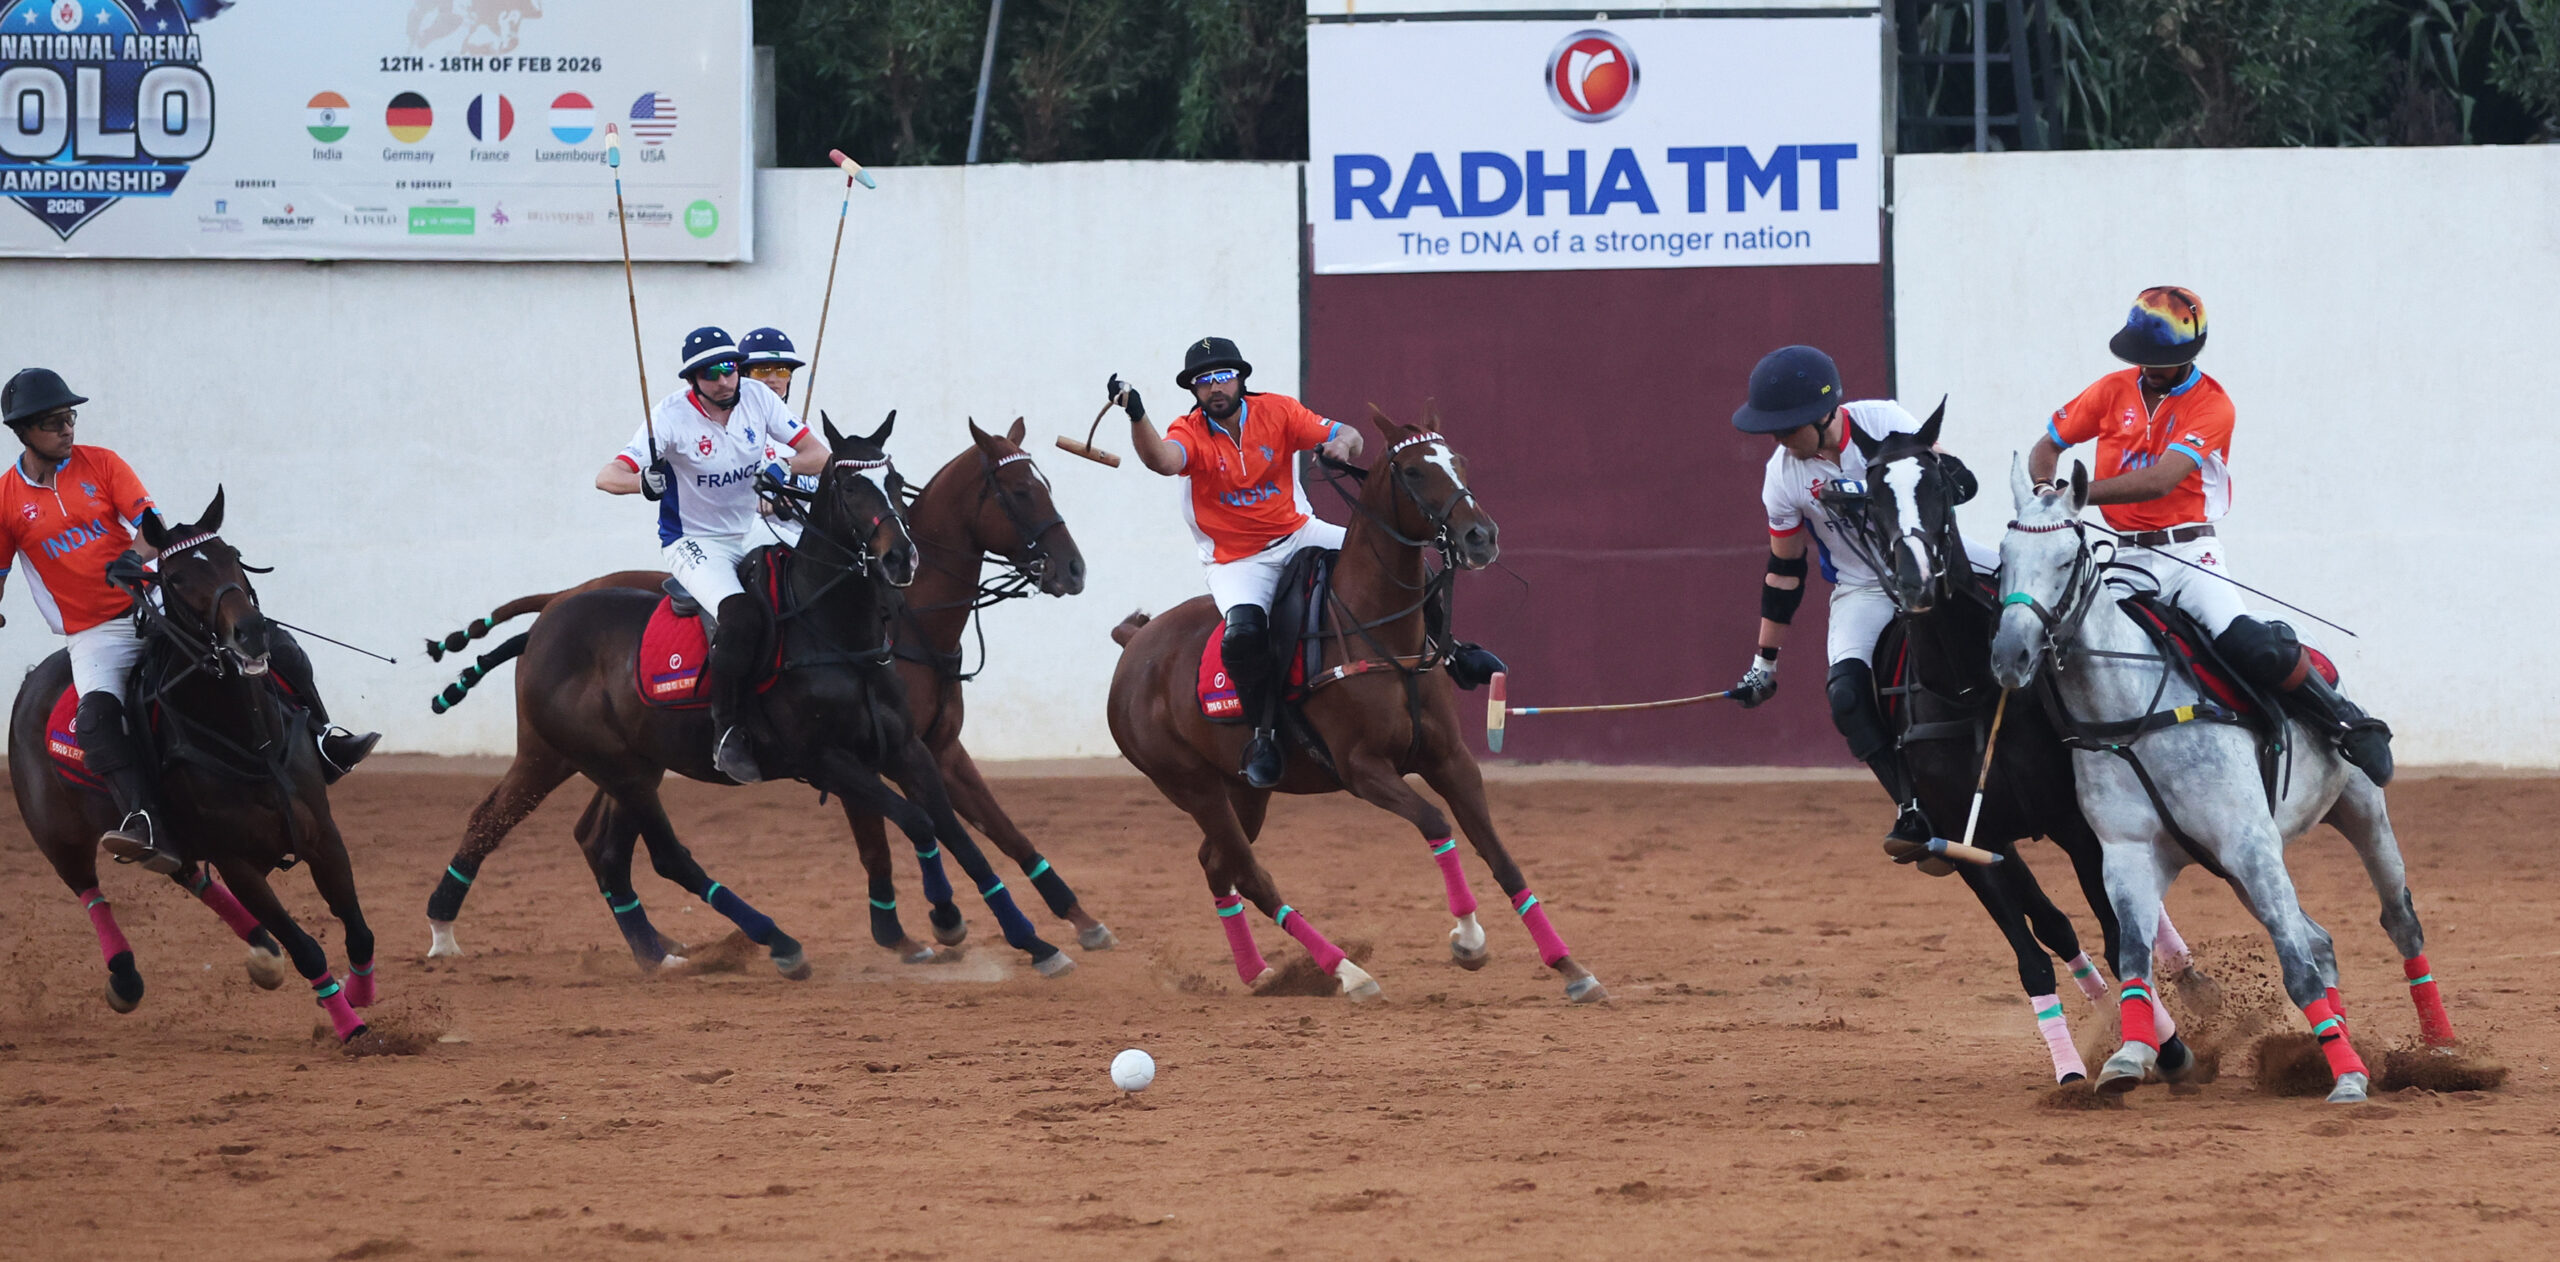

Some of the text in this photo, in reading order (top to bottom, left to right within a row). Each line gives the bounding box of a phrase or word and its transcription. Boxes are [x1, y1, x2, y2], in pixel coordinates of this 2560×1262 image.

[1, 34, 201, 61] NATIONAL ARENA
[380, 57, 424, 72] 12TH
[440, 57, 483, 72] 18TH
[489, 57, 513, 72] OF
[518, 57, 552, 72] FEB
[557, 57, 603, 72] 2026
[0, 65, 213, 159] OLO
[313, 148, 343, 161] India
[383, 147, 435, 164] Germany
[470, 148, 509, 161] France
[535, 148, 607, 163] Luxembourg
[640, 149, 666, 162] USA
[0, 171, 167, 191] AMPIONSHIP
[1333, 143, 1859, 220] RADHA TMT
[47, 200, 85, 215] 2026
[1398, 227, 1812, 258] The DNA of a stronger nation
[696, 459, 762, 488] FRANCE
[1219, 480, 1282, 507] INDIA
[41, 518, 110, 560] INDIA
